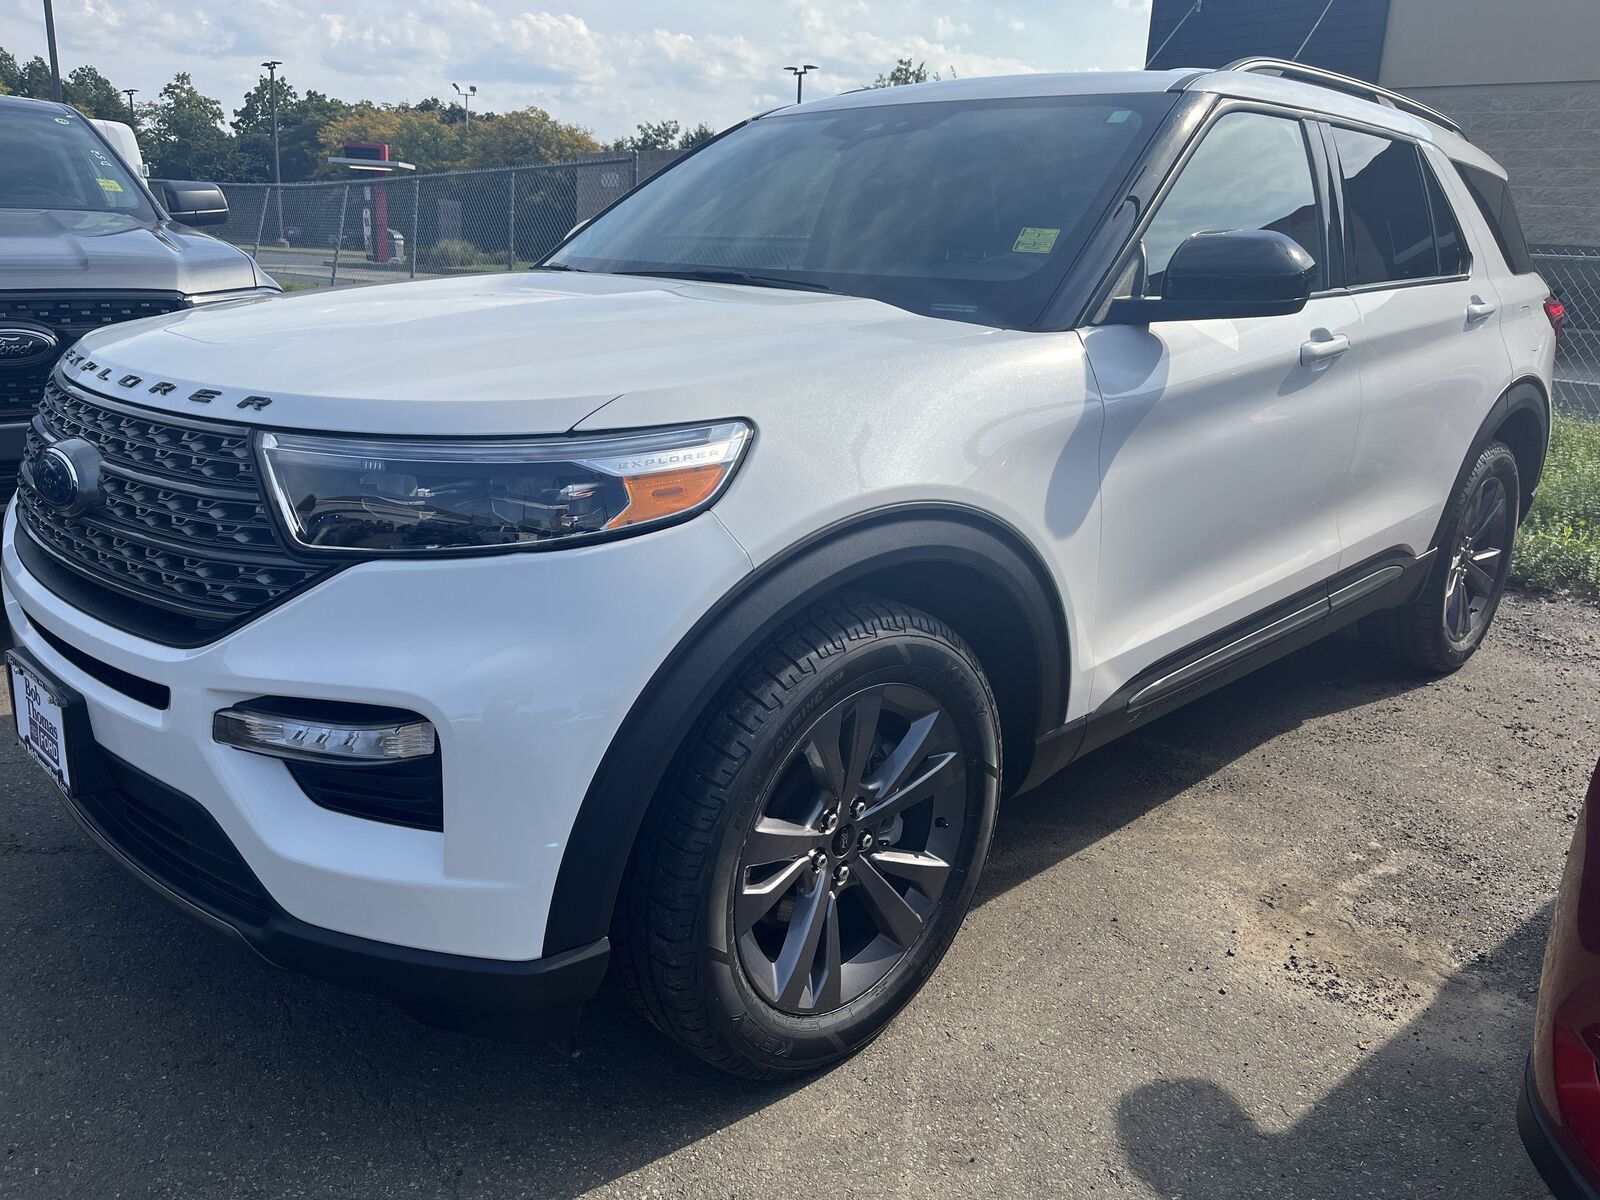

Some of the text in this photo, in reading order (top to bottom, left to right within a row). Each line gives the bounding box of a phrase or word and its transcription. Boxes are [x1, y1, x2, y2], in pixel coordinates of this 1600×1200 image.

[64, 348, 273, 411] EXPLORER
[618, 449, 720, 470] EXPLORER
[24, 676, 41, 706] Bob
[26, 696, 59, 741] Thomas
